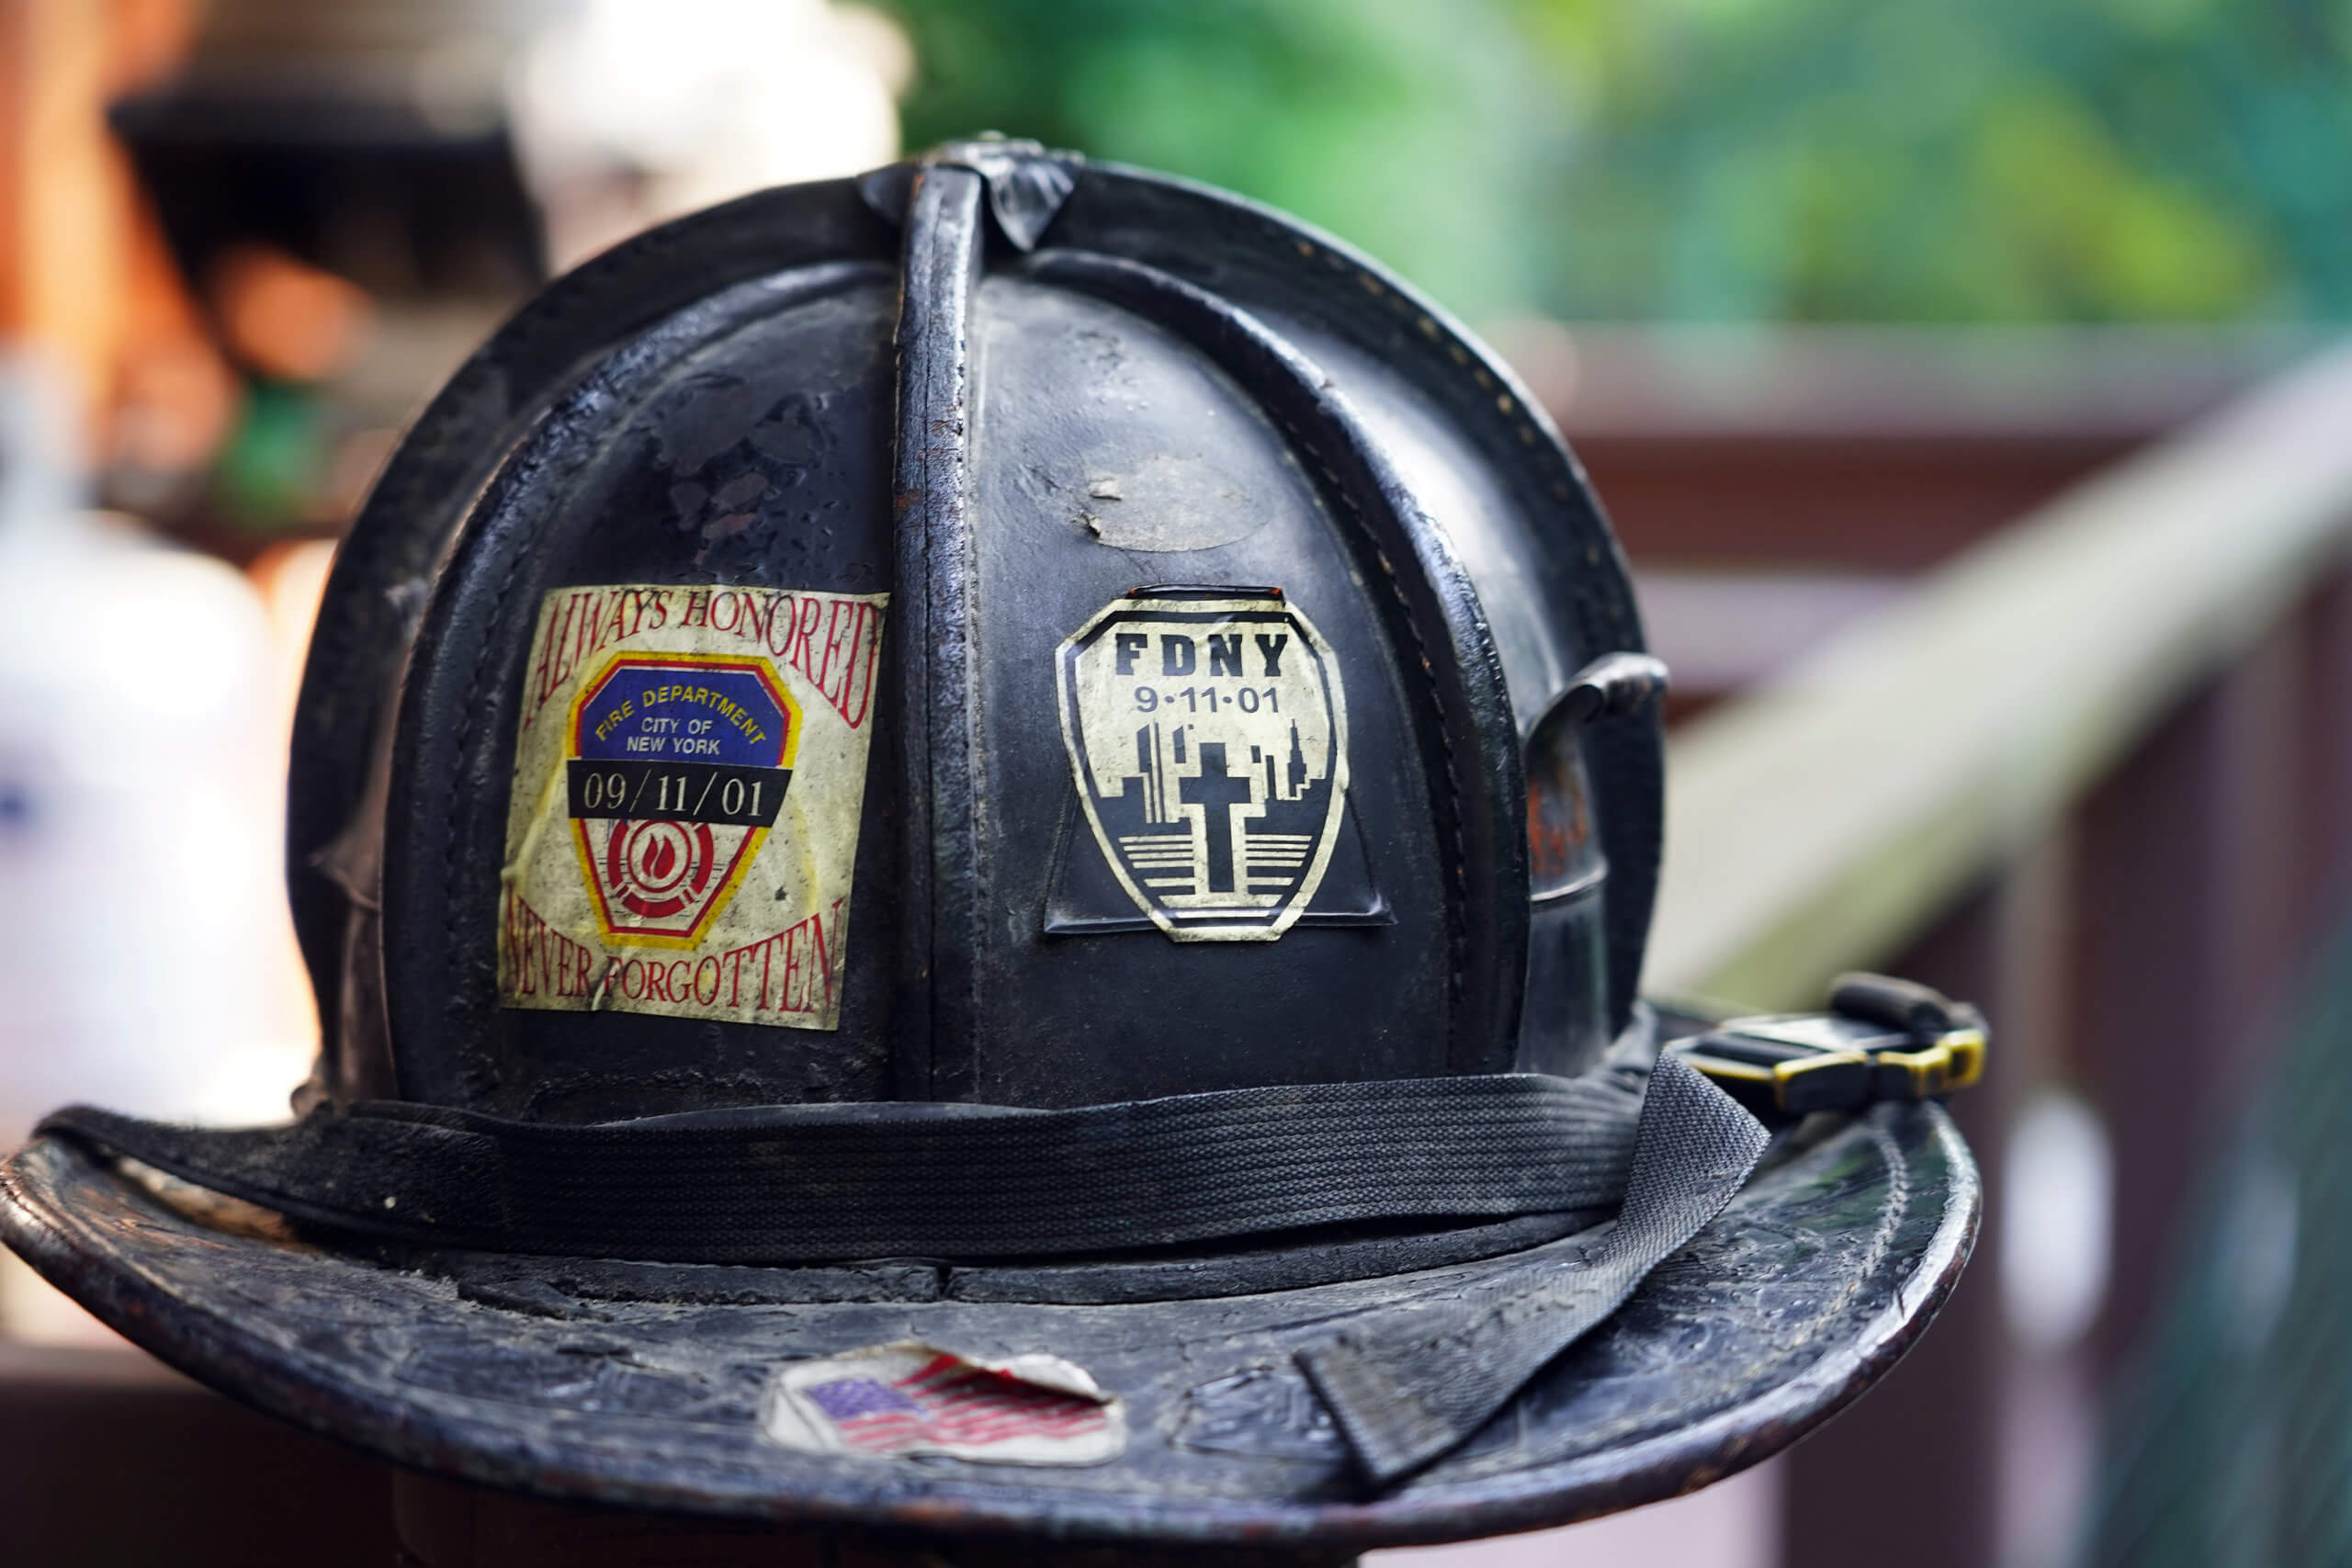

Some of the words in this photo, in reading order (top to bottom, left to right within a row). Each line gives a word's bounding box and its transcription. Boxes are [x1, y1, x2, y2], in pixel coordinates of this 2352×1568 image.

[523, 589, 673, 730] ALWAYS
[682, 590, 878, 729] HONORED
[1114, 632, 1288, 678] FDNY
[595, 699, 636, 742] FIRE
[642, 684, 766, 746] DEPARTMENT
[640, 716, 680, 734] CITY
[688, 718, 713, 736] OF
[626, 736, 666, 752] NEW
[673, 738, 721, 756] YORK
[583, 768, 763, 817] 09/11/01
[503, 879, 593, 998] NEVER
[602, 896, 845, 1013] FORGOTTEN
